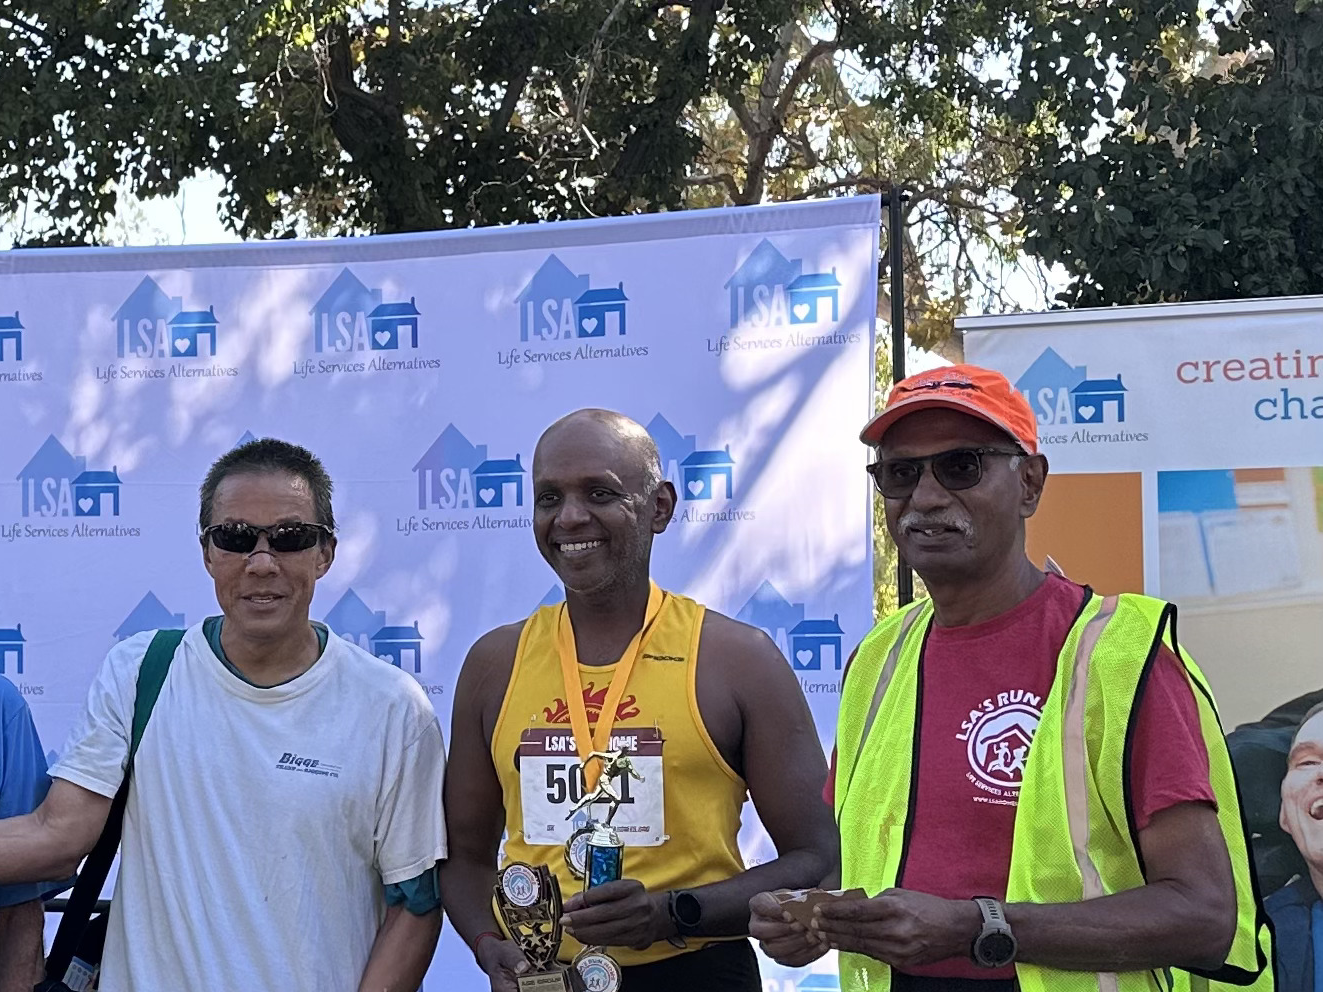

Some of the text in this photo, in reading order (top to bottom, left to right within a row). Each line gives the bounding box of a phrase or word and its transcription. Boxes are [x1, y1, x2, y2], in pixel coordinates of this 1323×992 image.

[322, 311, 371, 353] LSA
[527, 298, 577, 341] LSA
[124, 318, 171, 358] LSA
[706, 337, 730, 355] Life
[785, 330, 861, 347] Alternatives
[293, 357, 441, 379] Life Services Alternatives
[498, 344, 649, 369] Life Services Alternatives
[96, 364, 238, 384] Life Services Alternatives
[1036, 429, 1149, 445] vices Alternatives
[28, 477, 74, 517] LSA
[427, 468, 476, 509] LSA
[397, 515, 533, 536] Life Services Alternativ
[680, 507, 756, 523] Alternatives
[1, 522, 141, 542] Life Services Alternatives
[955, 689, 1041, 741] LSA'S RUN
[546, 764, 635, 804] 501
